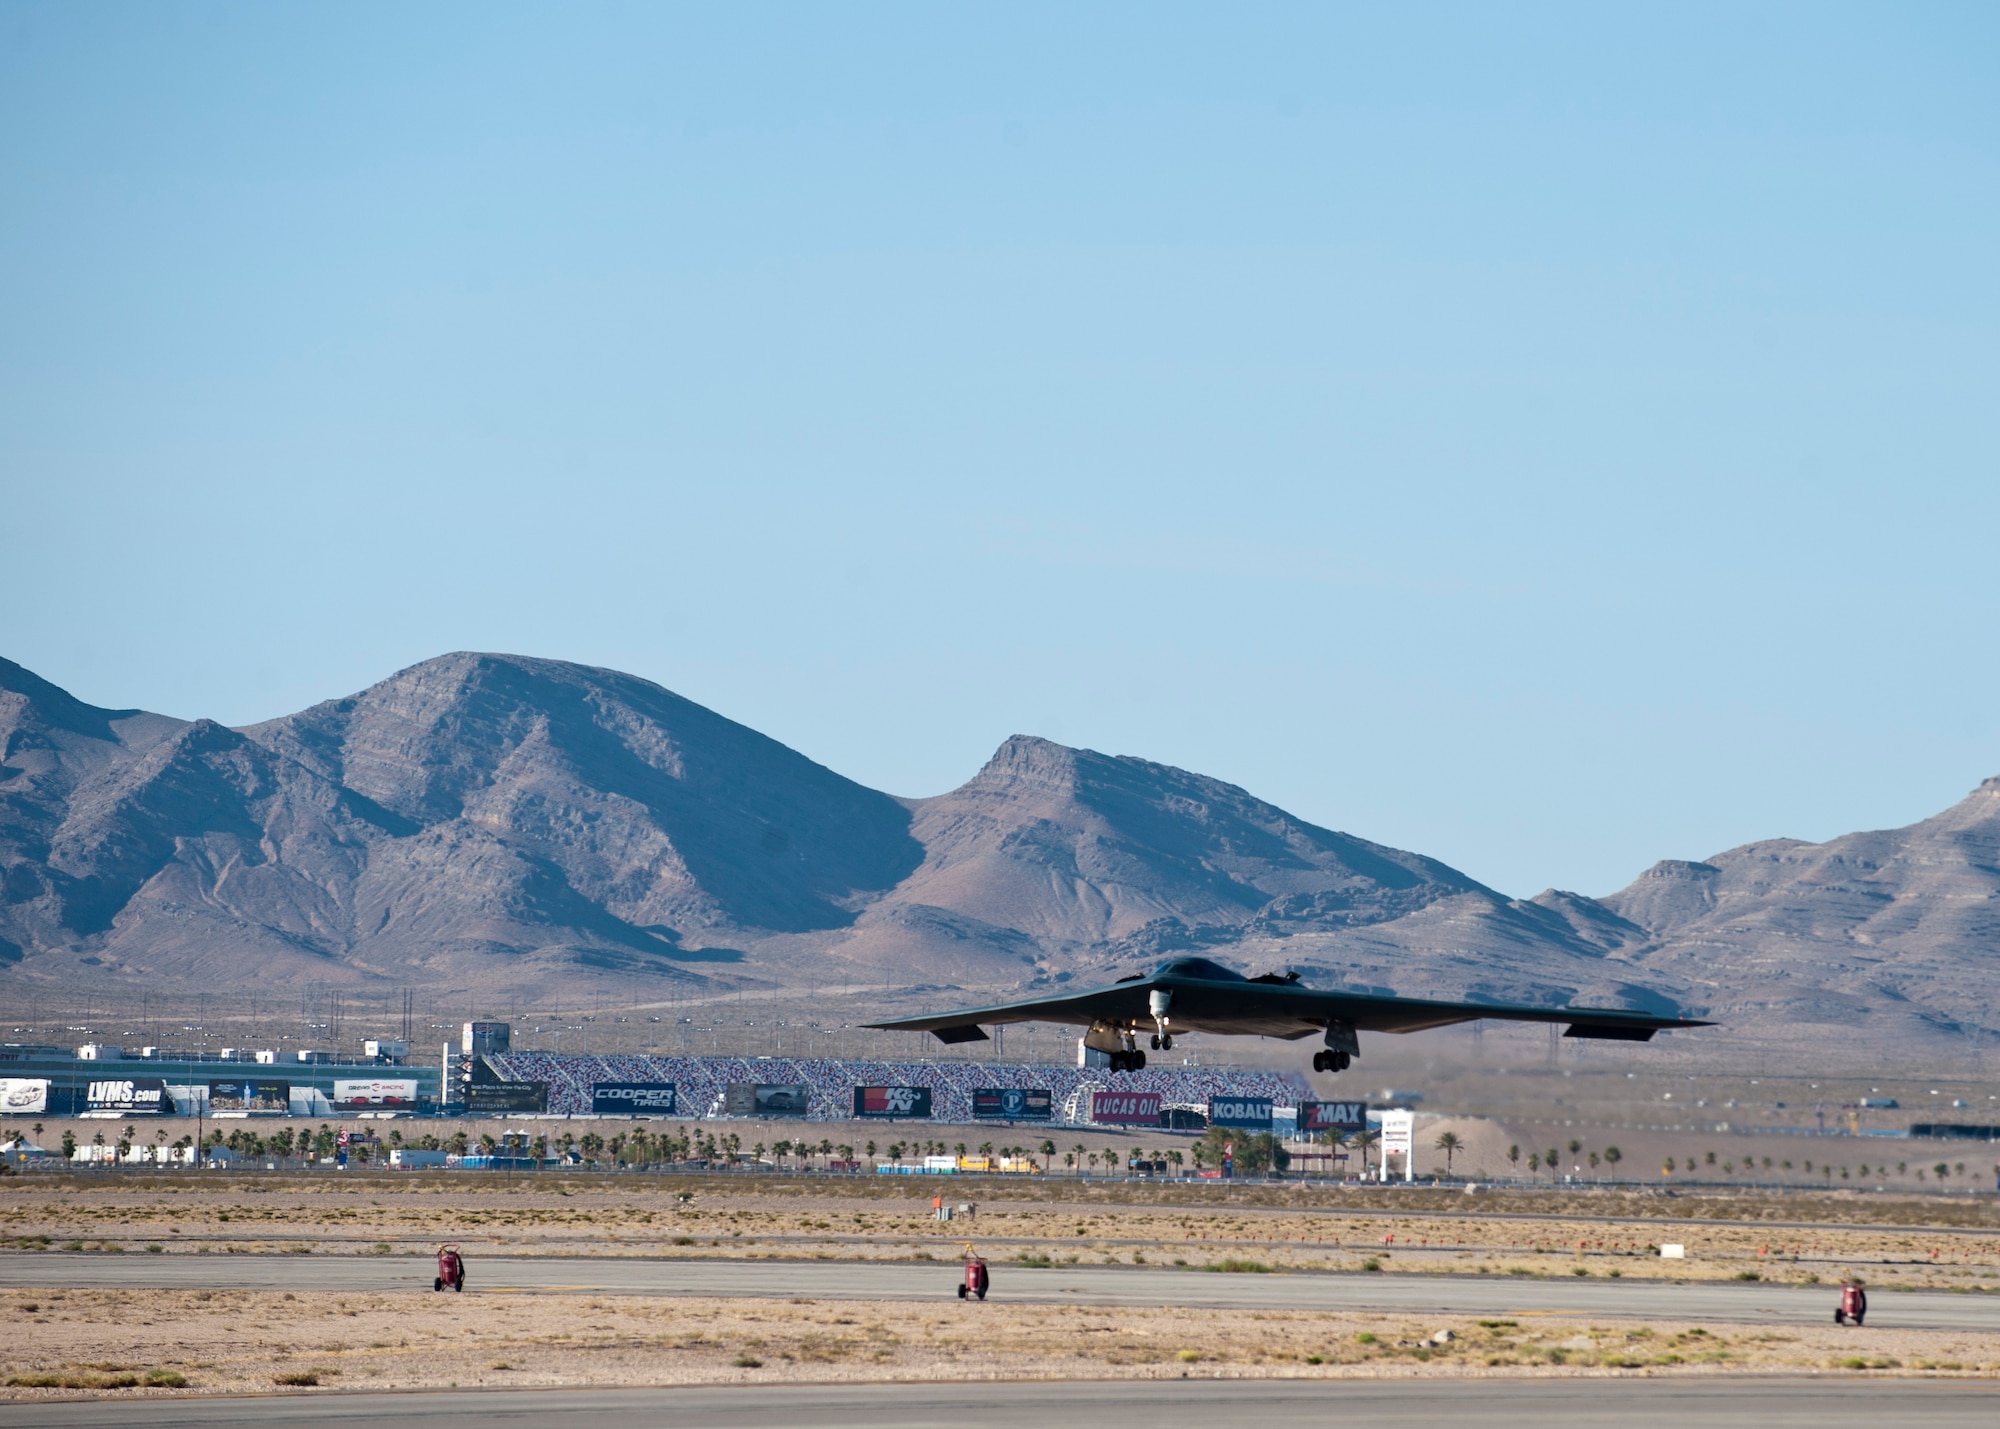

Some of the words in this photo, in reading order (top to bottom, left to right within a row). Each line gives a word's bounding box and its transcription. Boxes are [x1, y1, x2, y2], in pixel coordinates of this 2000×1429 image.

[87, 1081, 161, 1102] LVMS.com
[595, 1088, 674, 1099] COOPER
[632, 1099, 671, 1107] TIRES
[1008, 1094, 1020, 1109] P
[1095, 1098, 1136, 1115] LUCAS
[1139, 1098, 1159, 1116] OIL
[1213, 1103, 1272, 1120] KOBALT
[340, 1130, 348, 1143] 3
[1225, 1145, 1232, 1156] 4
